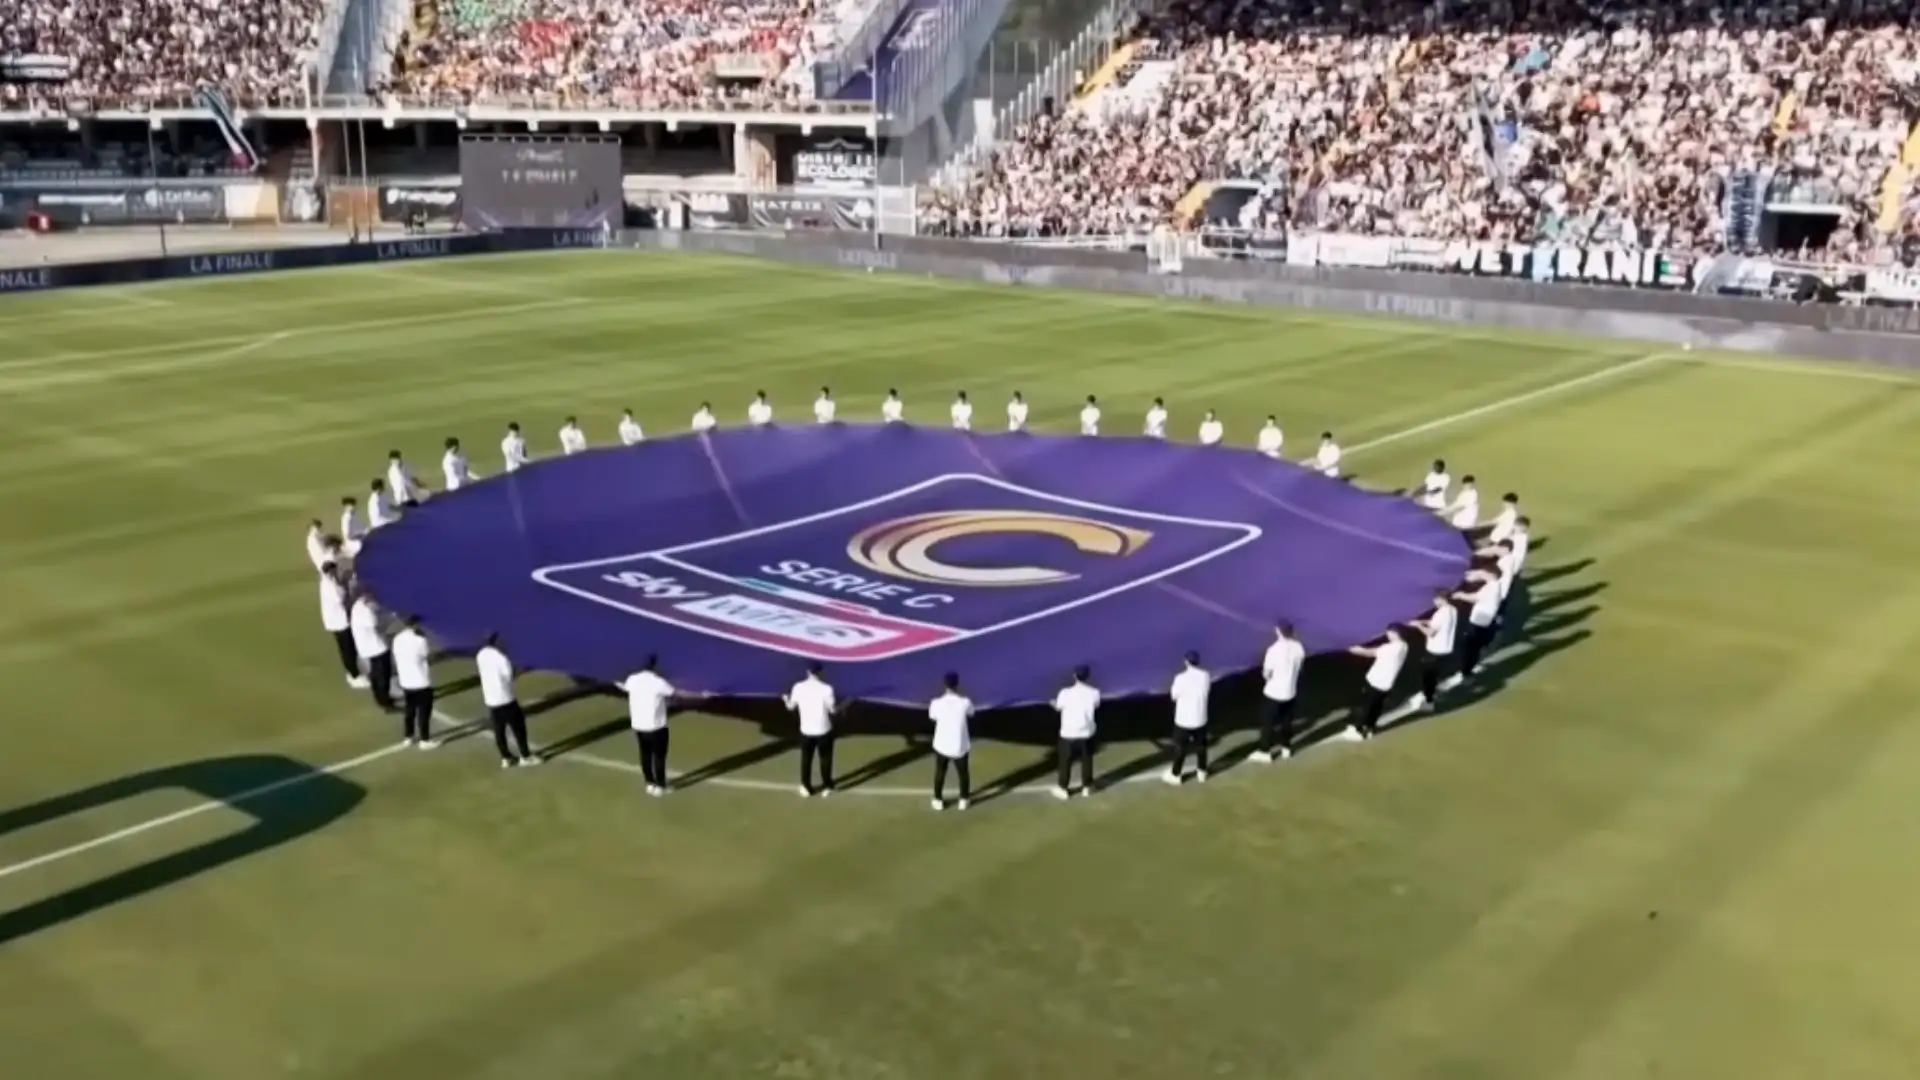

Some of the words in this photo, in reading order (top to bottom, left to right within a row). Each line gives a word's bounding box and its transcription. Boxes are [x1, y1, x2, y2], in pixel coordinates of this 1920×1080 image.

[552, 231, 571, 247] LA
[189, 256, 213, 273] LA
[216, 252, 274, 272] FINALE
[601, 571, 712, 598] sky
[760, 559, 914, 600] SERIE
[901, 593, 955, 609] C
